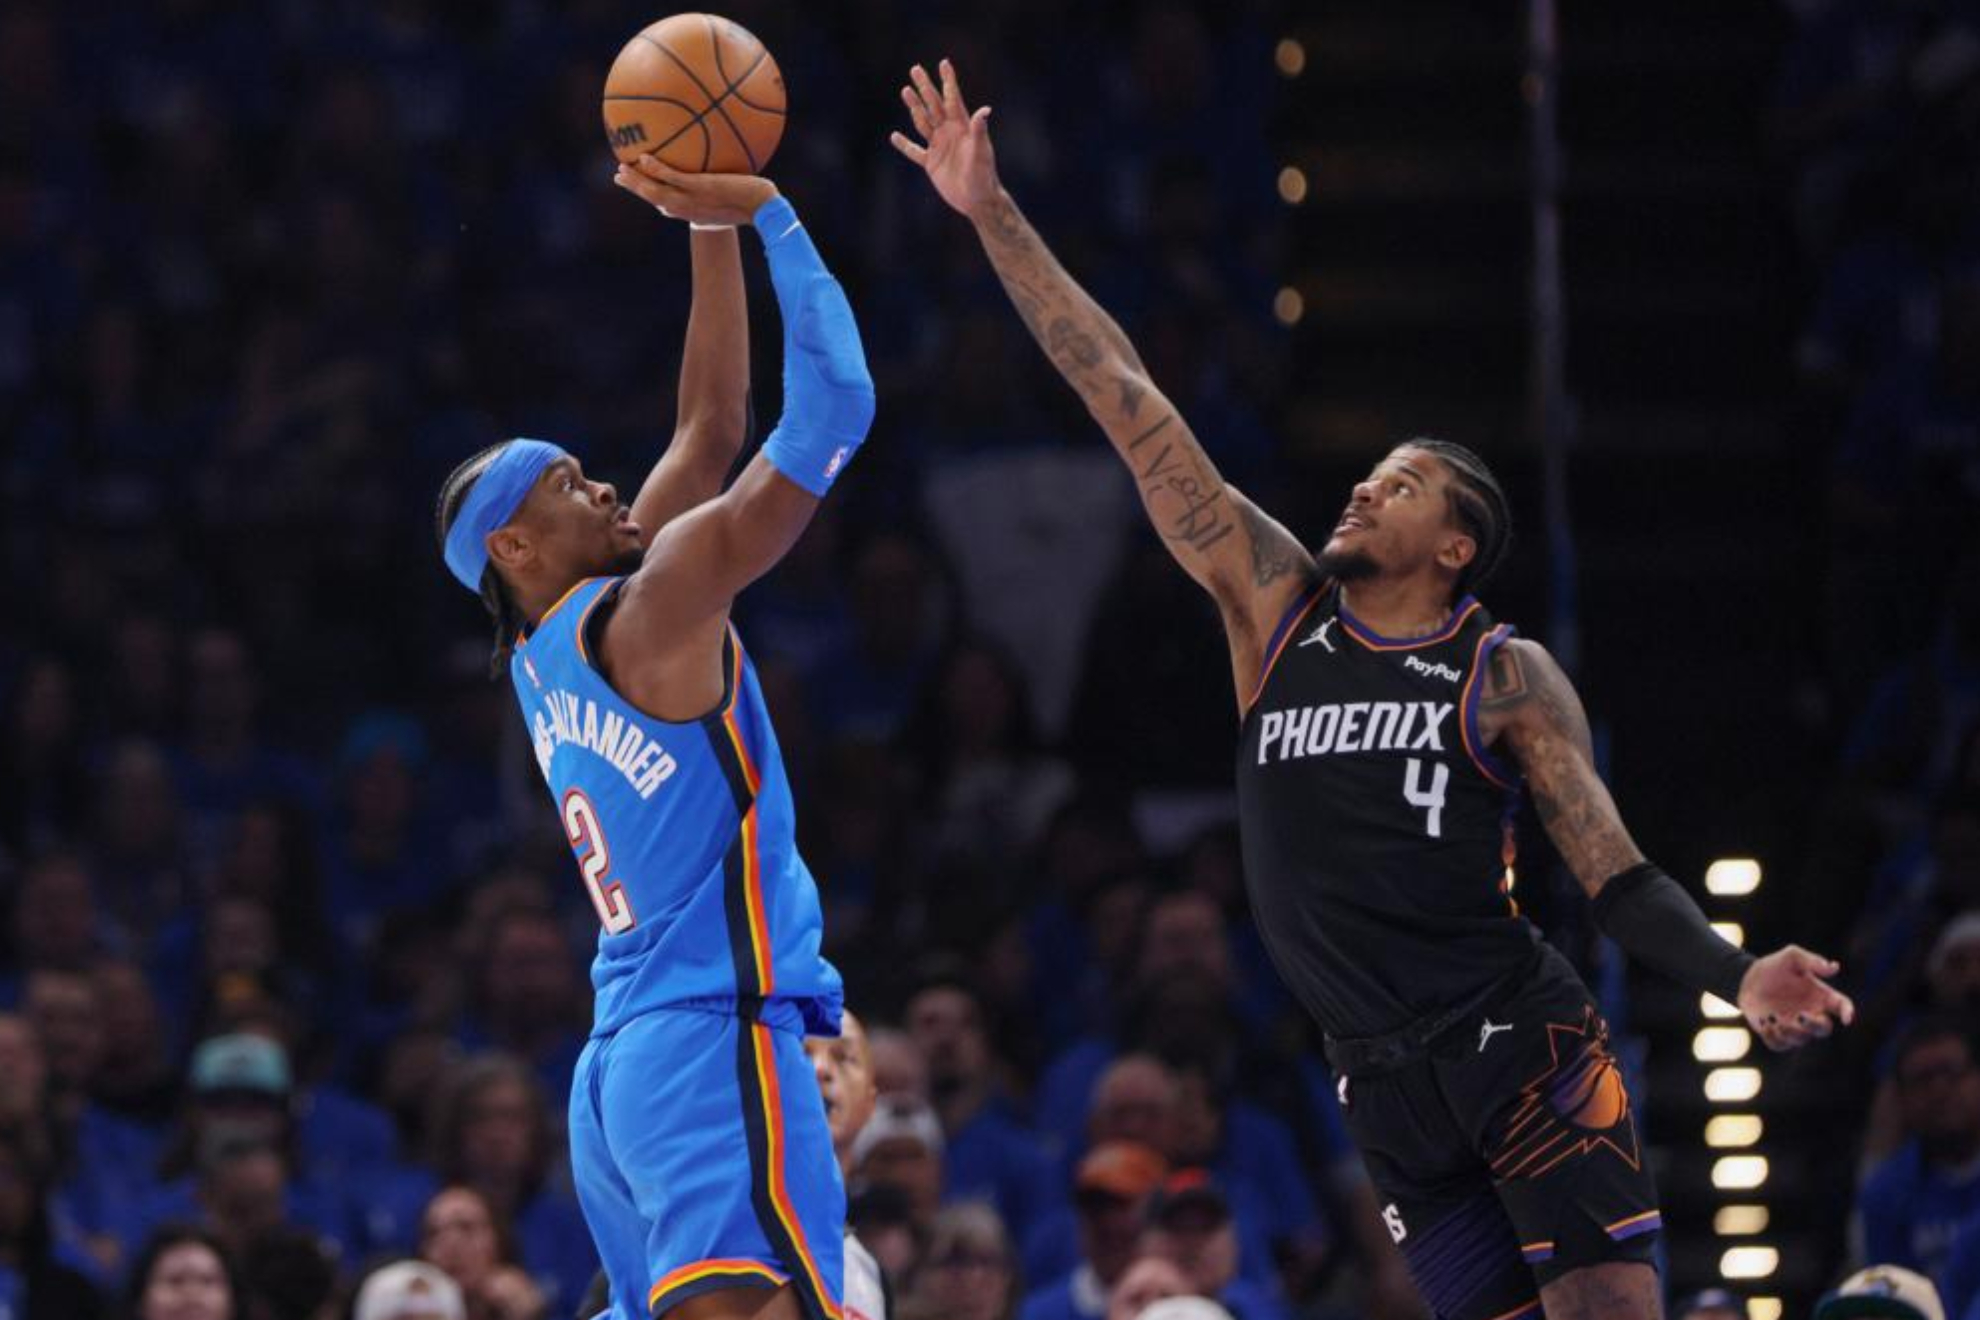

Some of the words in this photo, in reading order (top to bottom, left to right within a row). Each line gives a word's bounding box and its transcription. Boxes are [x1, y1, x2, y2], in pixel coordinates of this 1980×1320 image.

[1404, 655, 1461, 683] PayPal
[1258, 701, 1455, 765] PHOENIX
[1403, 757, 1450, 838] 4
[562, 786, 637, 937] 2
